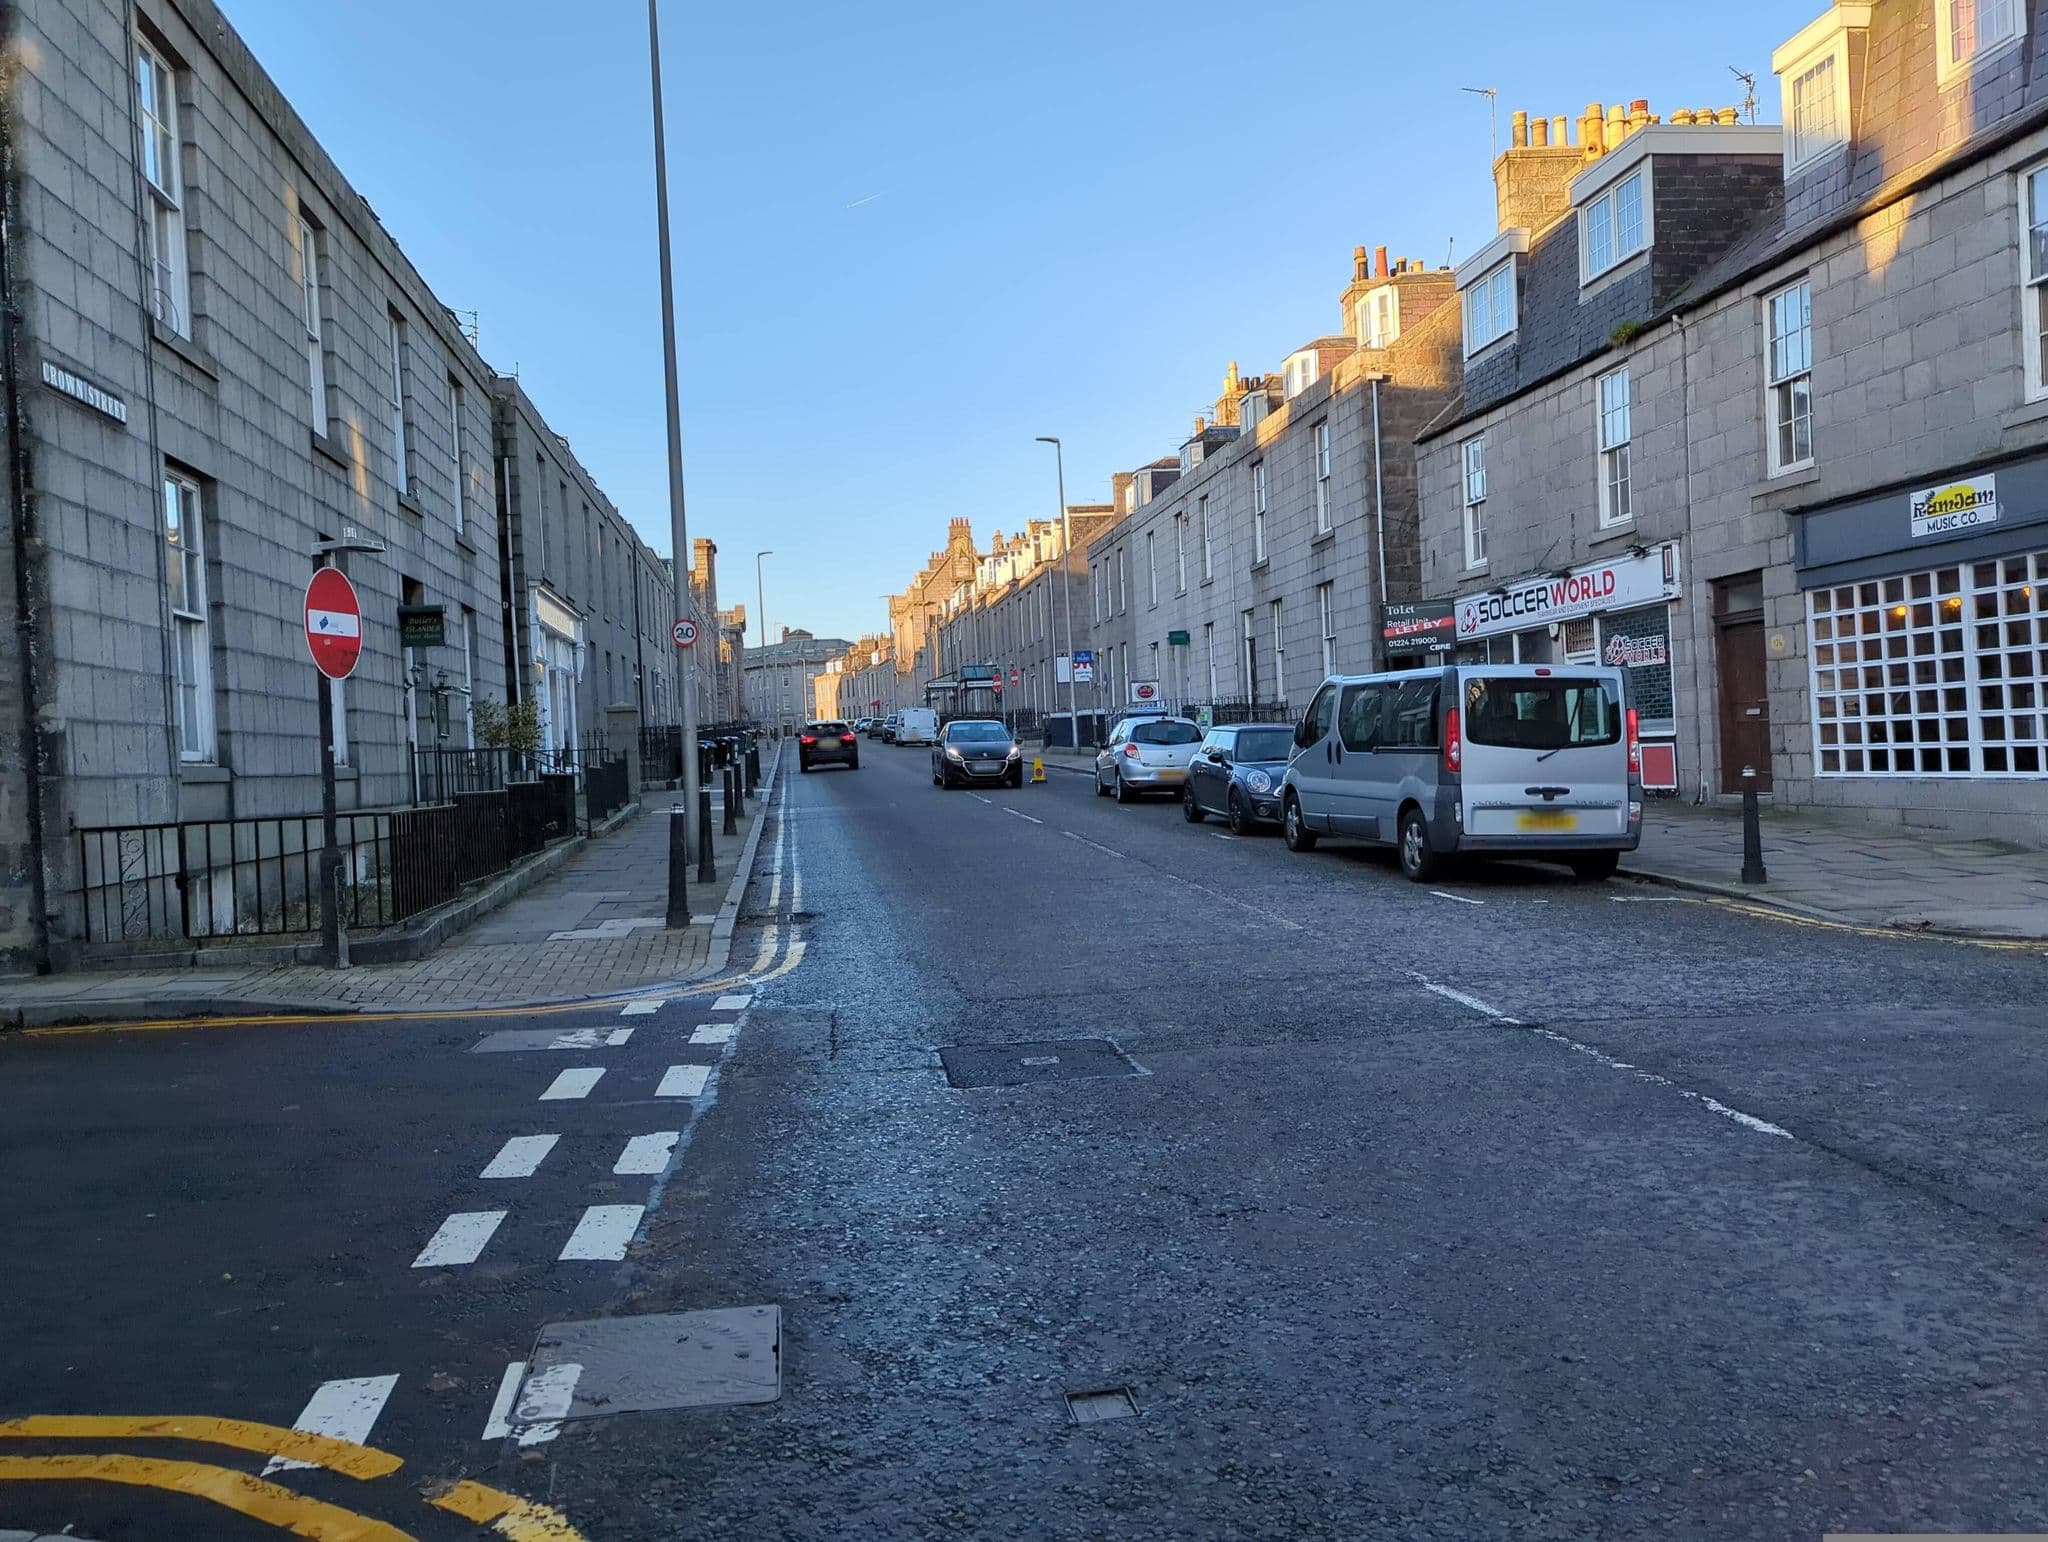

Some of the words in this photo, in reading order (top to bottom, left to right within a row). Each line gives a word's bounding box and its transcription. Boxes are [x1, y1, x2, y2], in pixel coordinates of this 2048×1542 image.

[43, 362, 84, 399] CROWN
[88, 386, 126, 423] STREET
[1927, 515, 1958, 533] MUSIC
[1961, 511, 1981, 525] CO.
[1386, 606, 1399, 615] To
[1400, 605, 1414, 614] Let
[676, 627, 695, 638] 20
[1395, 625, 1419, 635] LET
[1424, 619, 1442, 629] BY
[1388, 639, 1410, 647] 01224
[1411, 637, 1437, 645] 219000
[1625, 636, 1664, 650] SOCCER
